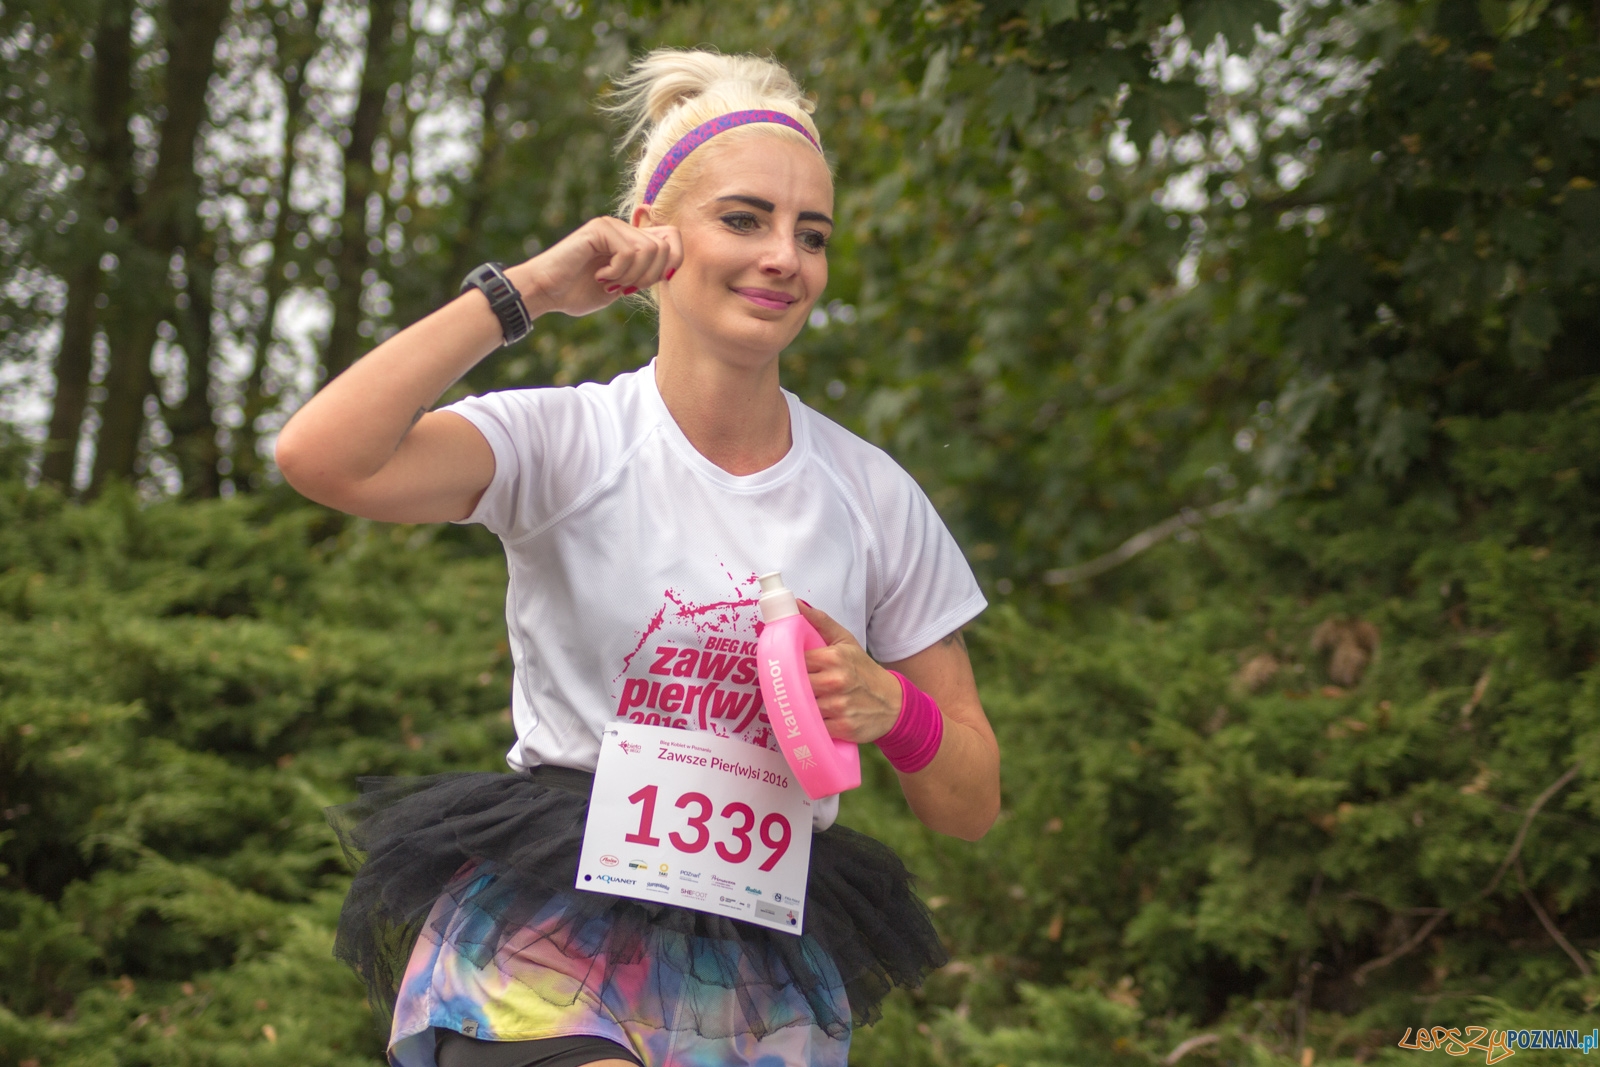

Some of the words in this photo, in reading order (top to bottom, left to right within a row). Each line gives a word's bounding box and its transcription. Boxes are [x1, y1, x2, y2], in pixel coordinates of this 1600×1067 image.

[704, 636, 740, 653] BIEG
[649, 646, 760, 687] zaws
[616, 678, 770, 733] pier(w)
[768, 658, 801, 739] karrimor
[657, 747, 707, 767] Zawsze
[710, 757, 760, 781] Pier(w)si
[762, 770, 789, 789] 2016
[624, 784, 792, 872] 1339
[596, 874, 637, 885] AQUANET
